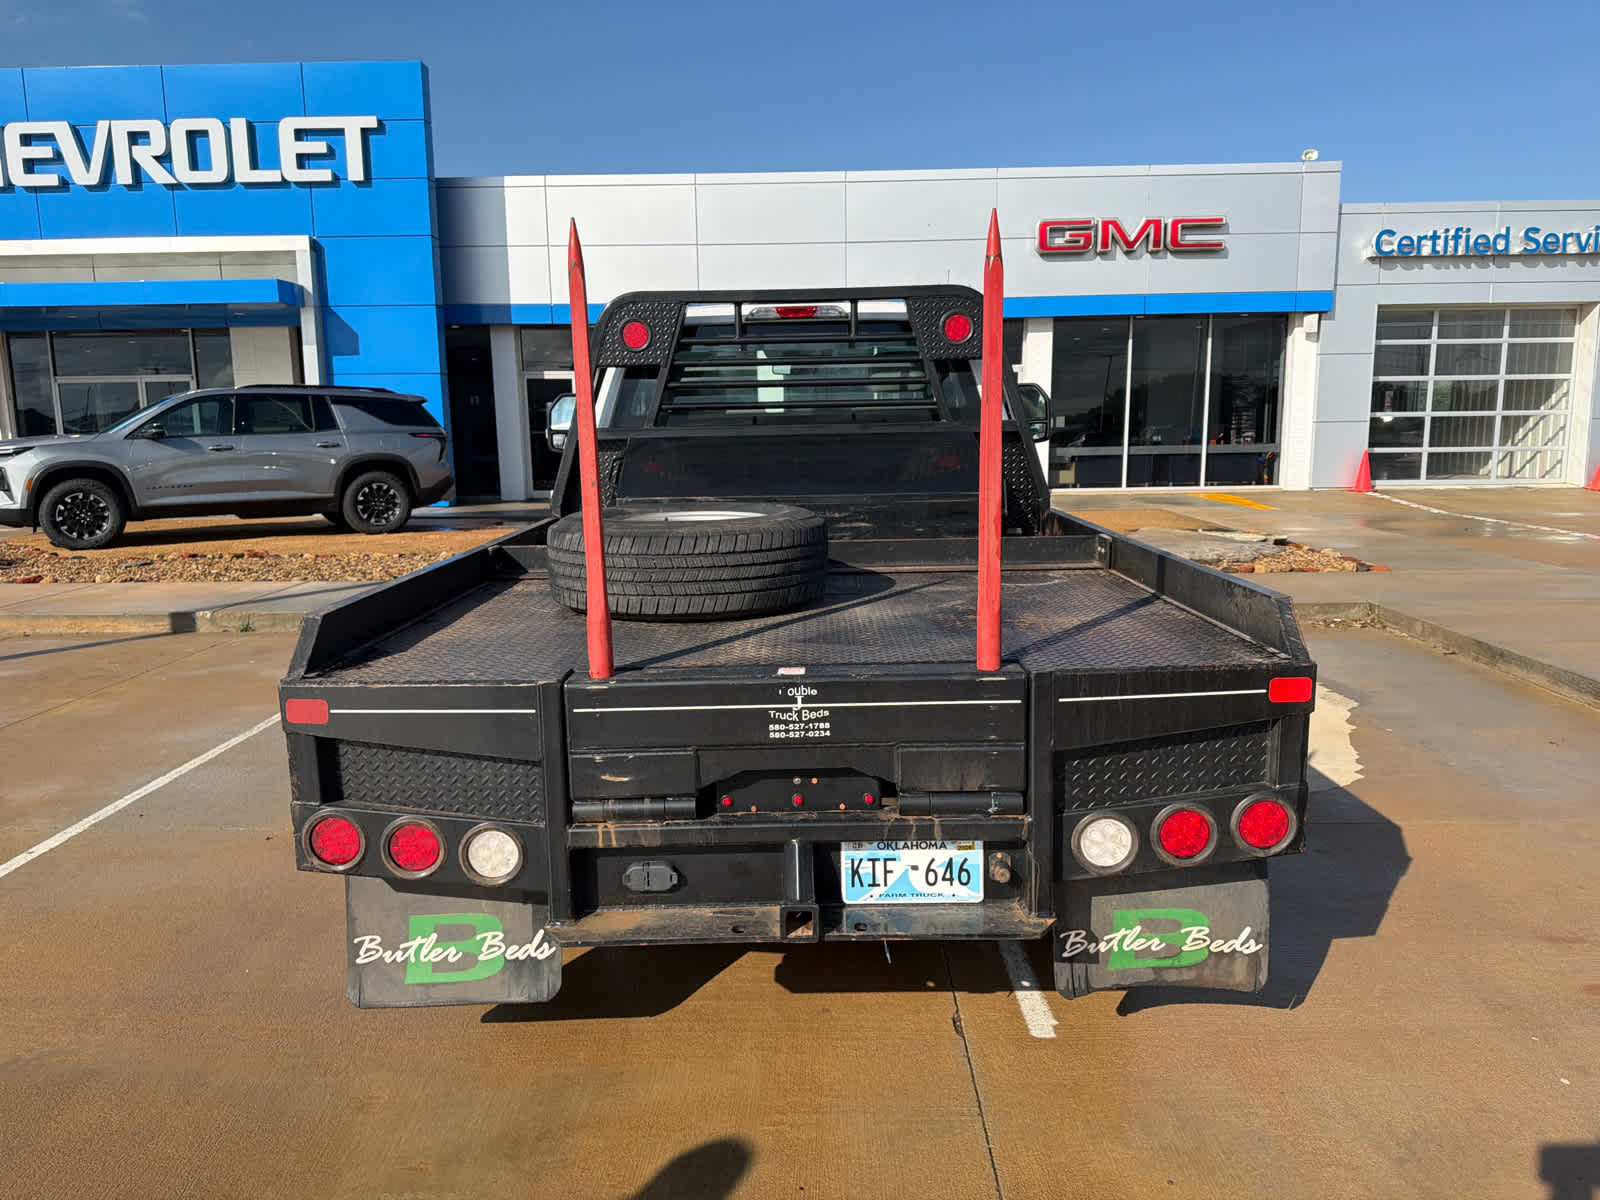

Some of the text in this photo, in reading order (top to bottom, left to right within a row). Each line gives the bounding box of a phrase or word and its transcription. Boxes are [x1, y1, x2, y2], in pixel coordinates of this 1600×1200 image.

[0, 116, 378, 187] EVROLET
[1036, 216, 1225, 253] GMC
[1375, 226, 1511, 256] Certified
[779, 685, 818, 696] ouble
[768, 709, 830, 721] Truck Beds
[877, 840, 947, 851] OKLAHOMA
[851, 857, 971, 888] KIF 646
[353, 929, 556, 965] Butler Beds
[1059, 926, 1263, 958] Butler Beds
